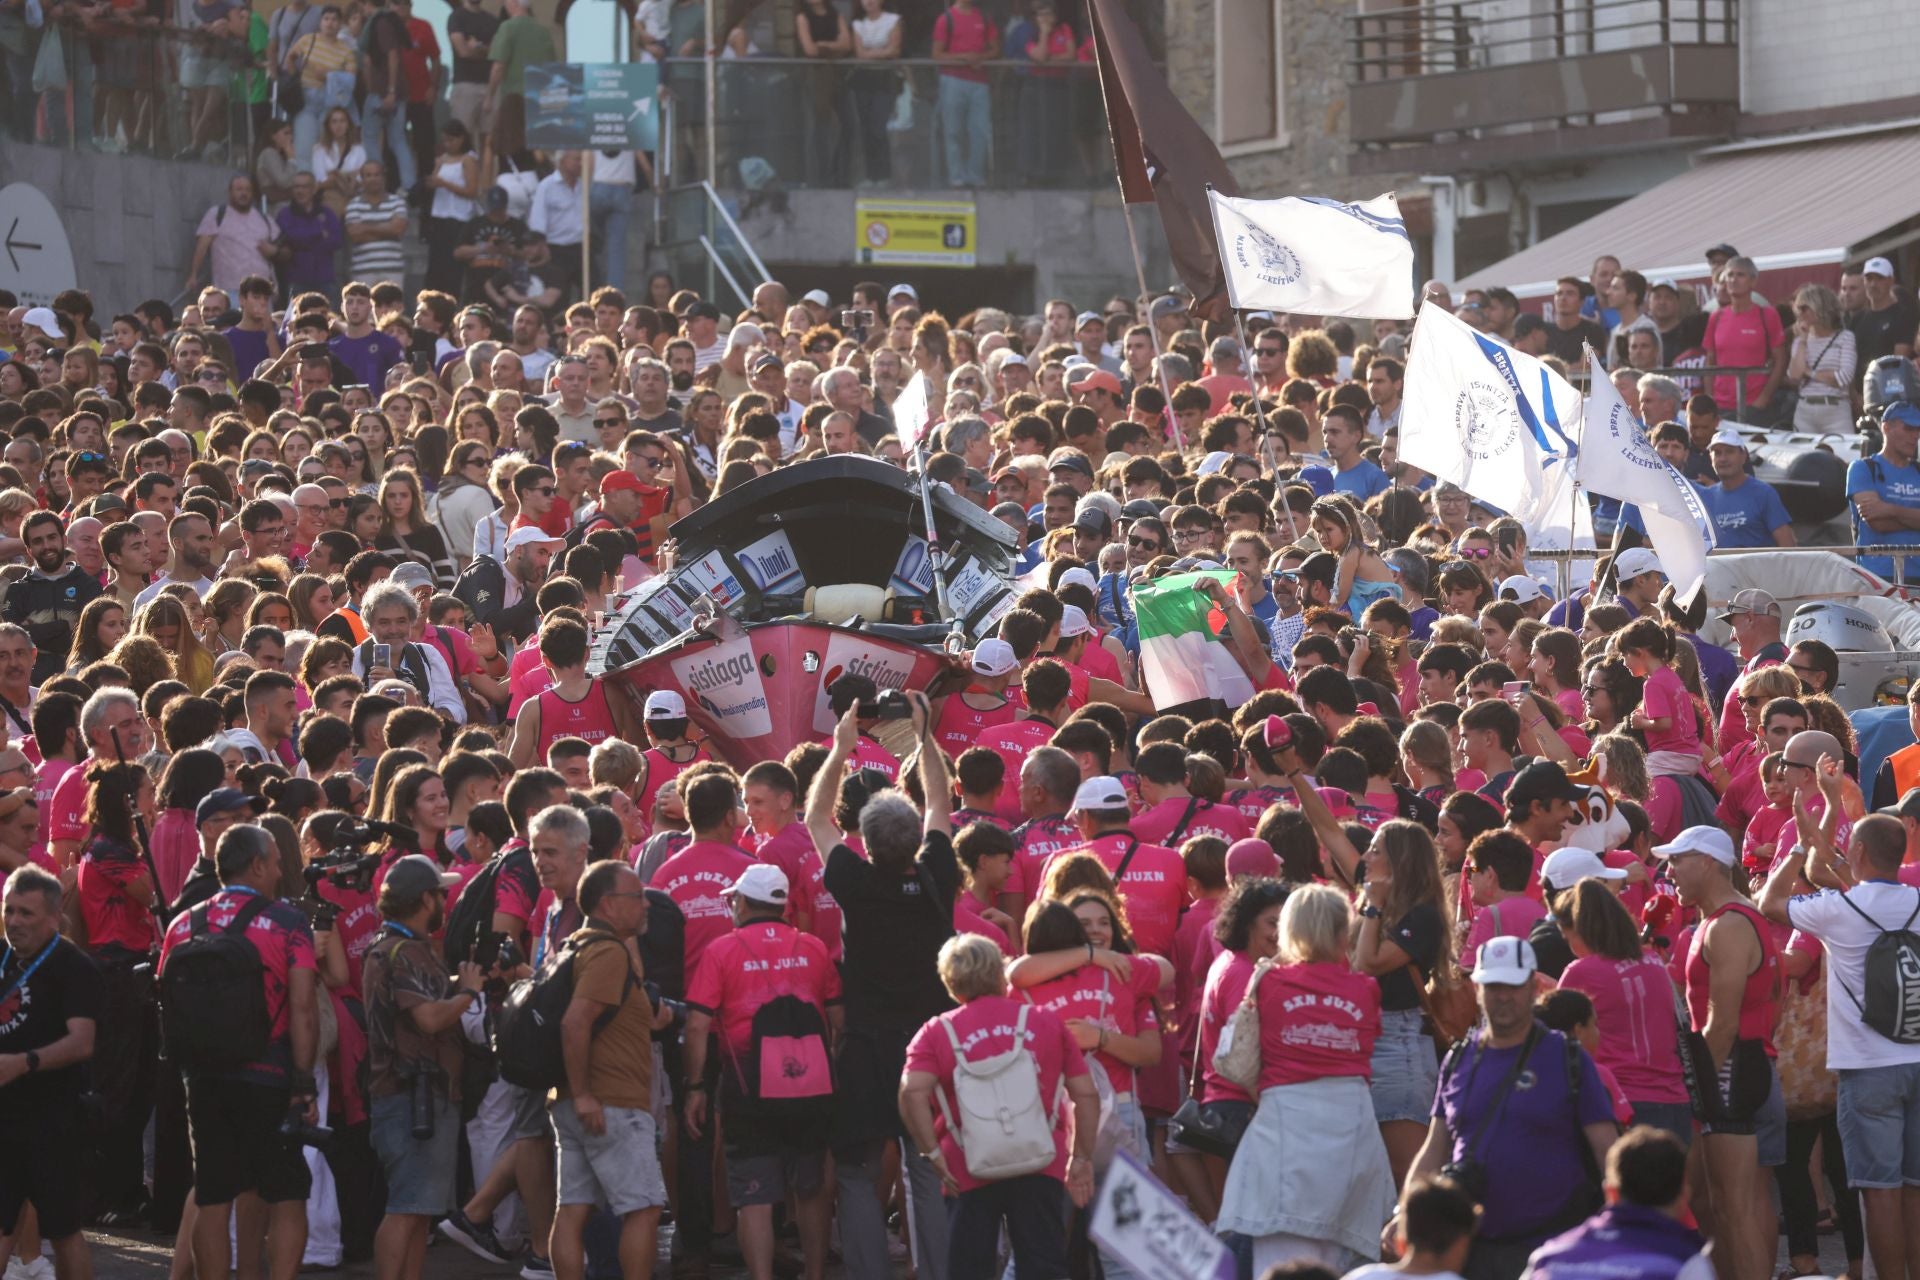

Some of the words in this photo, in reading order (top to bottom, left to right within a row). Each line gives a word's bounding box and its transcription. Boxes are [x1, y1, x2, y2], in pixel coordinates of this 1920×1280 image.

[757, 545, 792, 580] ilunki
[688, 652, 755, 691] sistiaga
[1121, 871, 1165, 883] JUAN
[1282, 994, 1317, 1013] SAN
[1323, 995, 1364, 1022] JUAN
